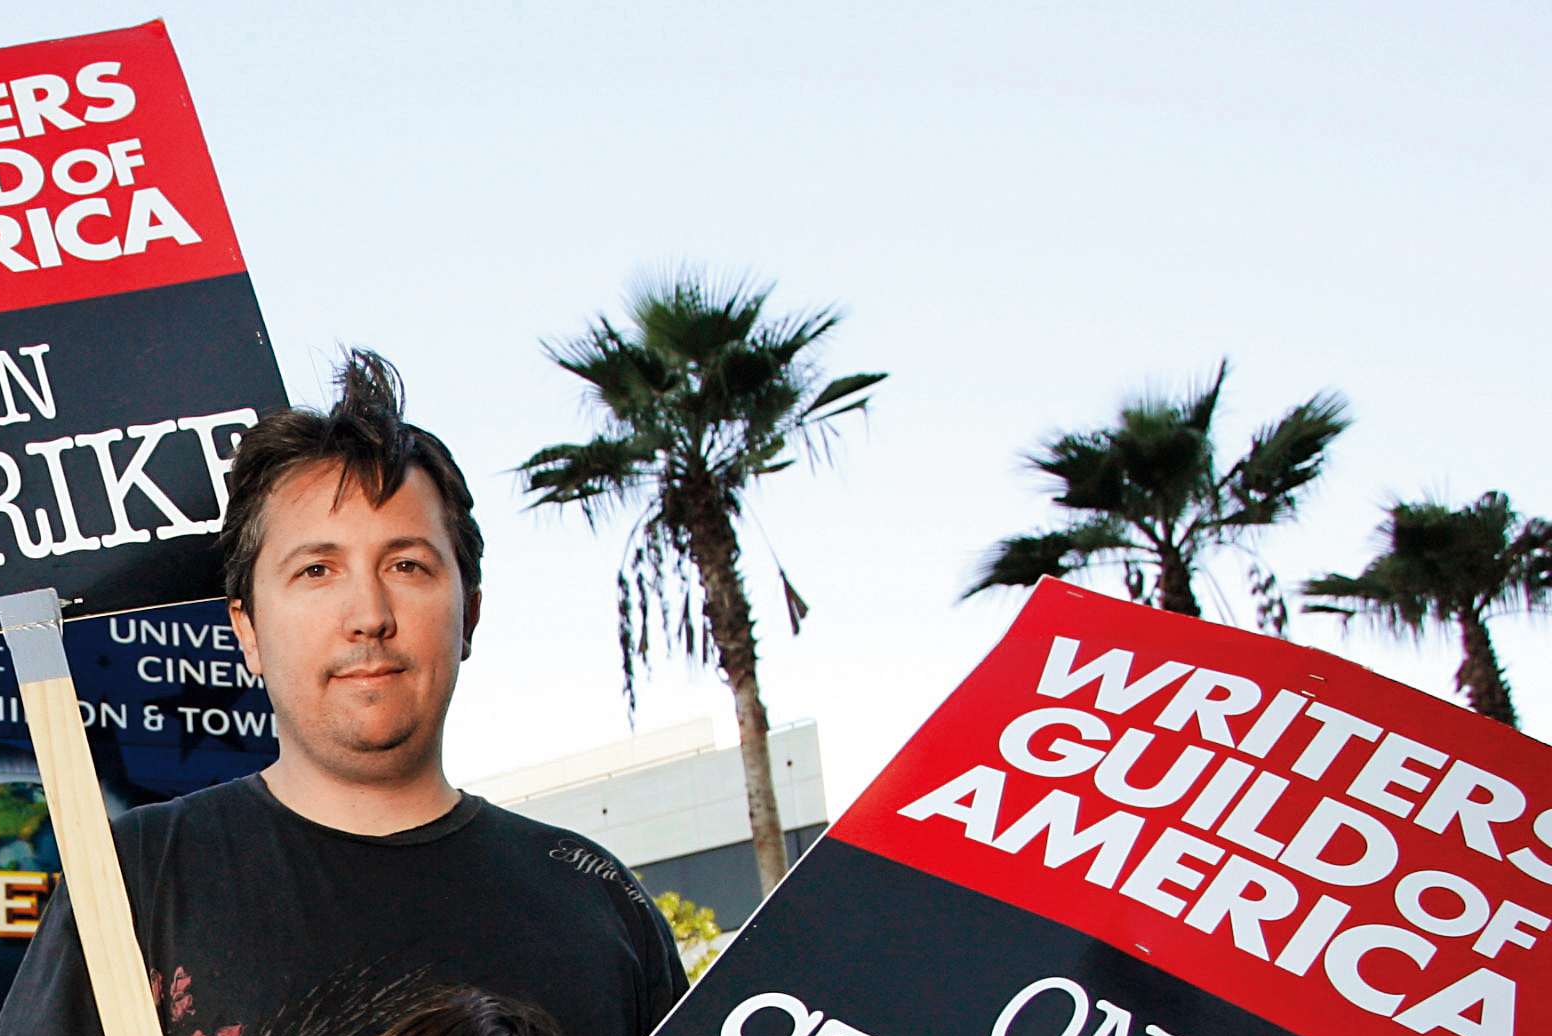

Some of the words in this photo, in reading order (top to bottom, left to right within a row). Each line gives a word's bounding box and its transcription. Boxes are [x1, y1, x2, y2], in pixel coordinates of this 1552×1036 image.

[51, 138, 145, 195] OF
[109, 617, 243, 652] UNIVE
[143, 705, 165, 731] &
[999, 707, 1399, 886] GUILD
[1394, 869, 1551, 959] OF
